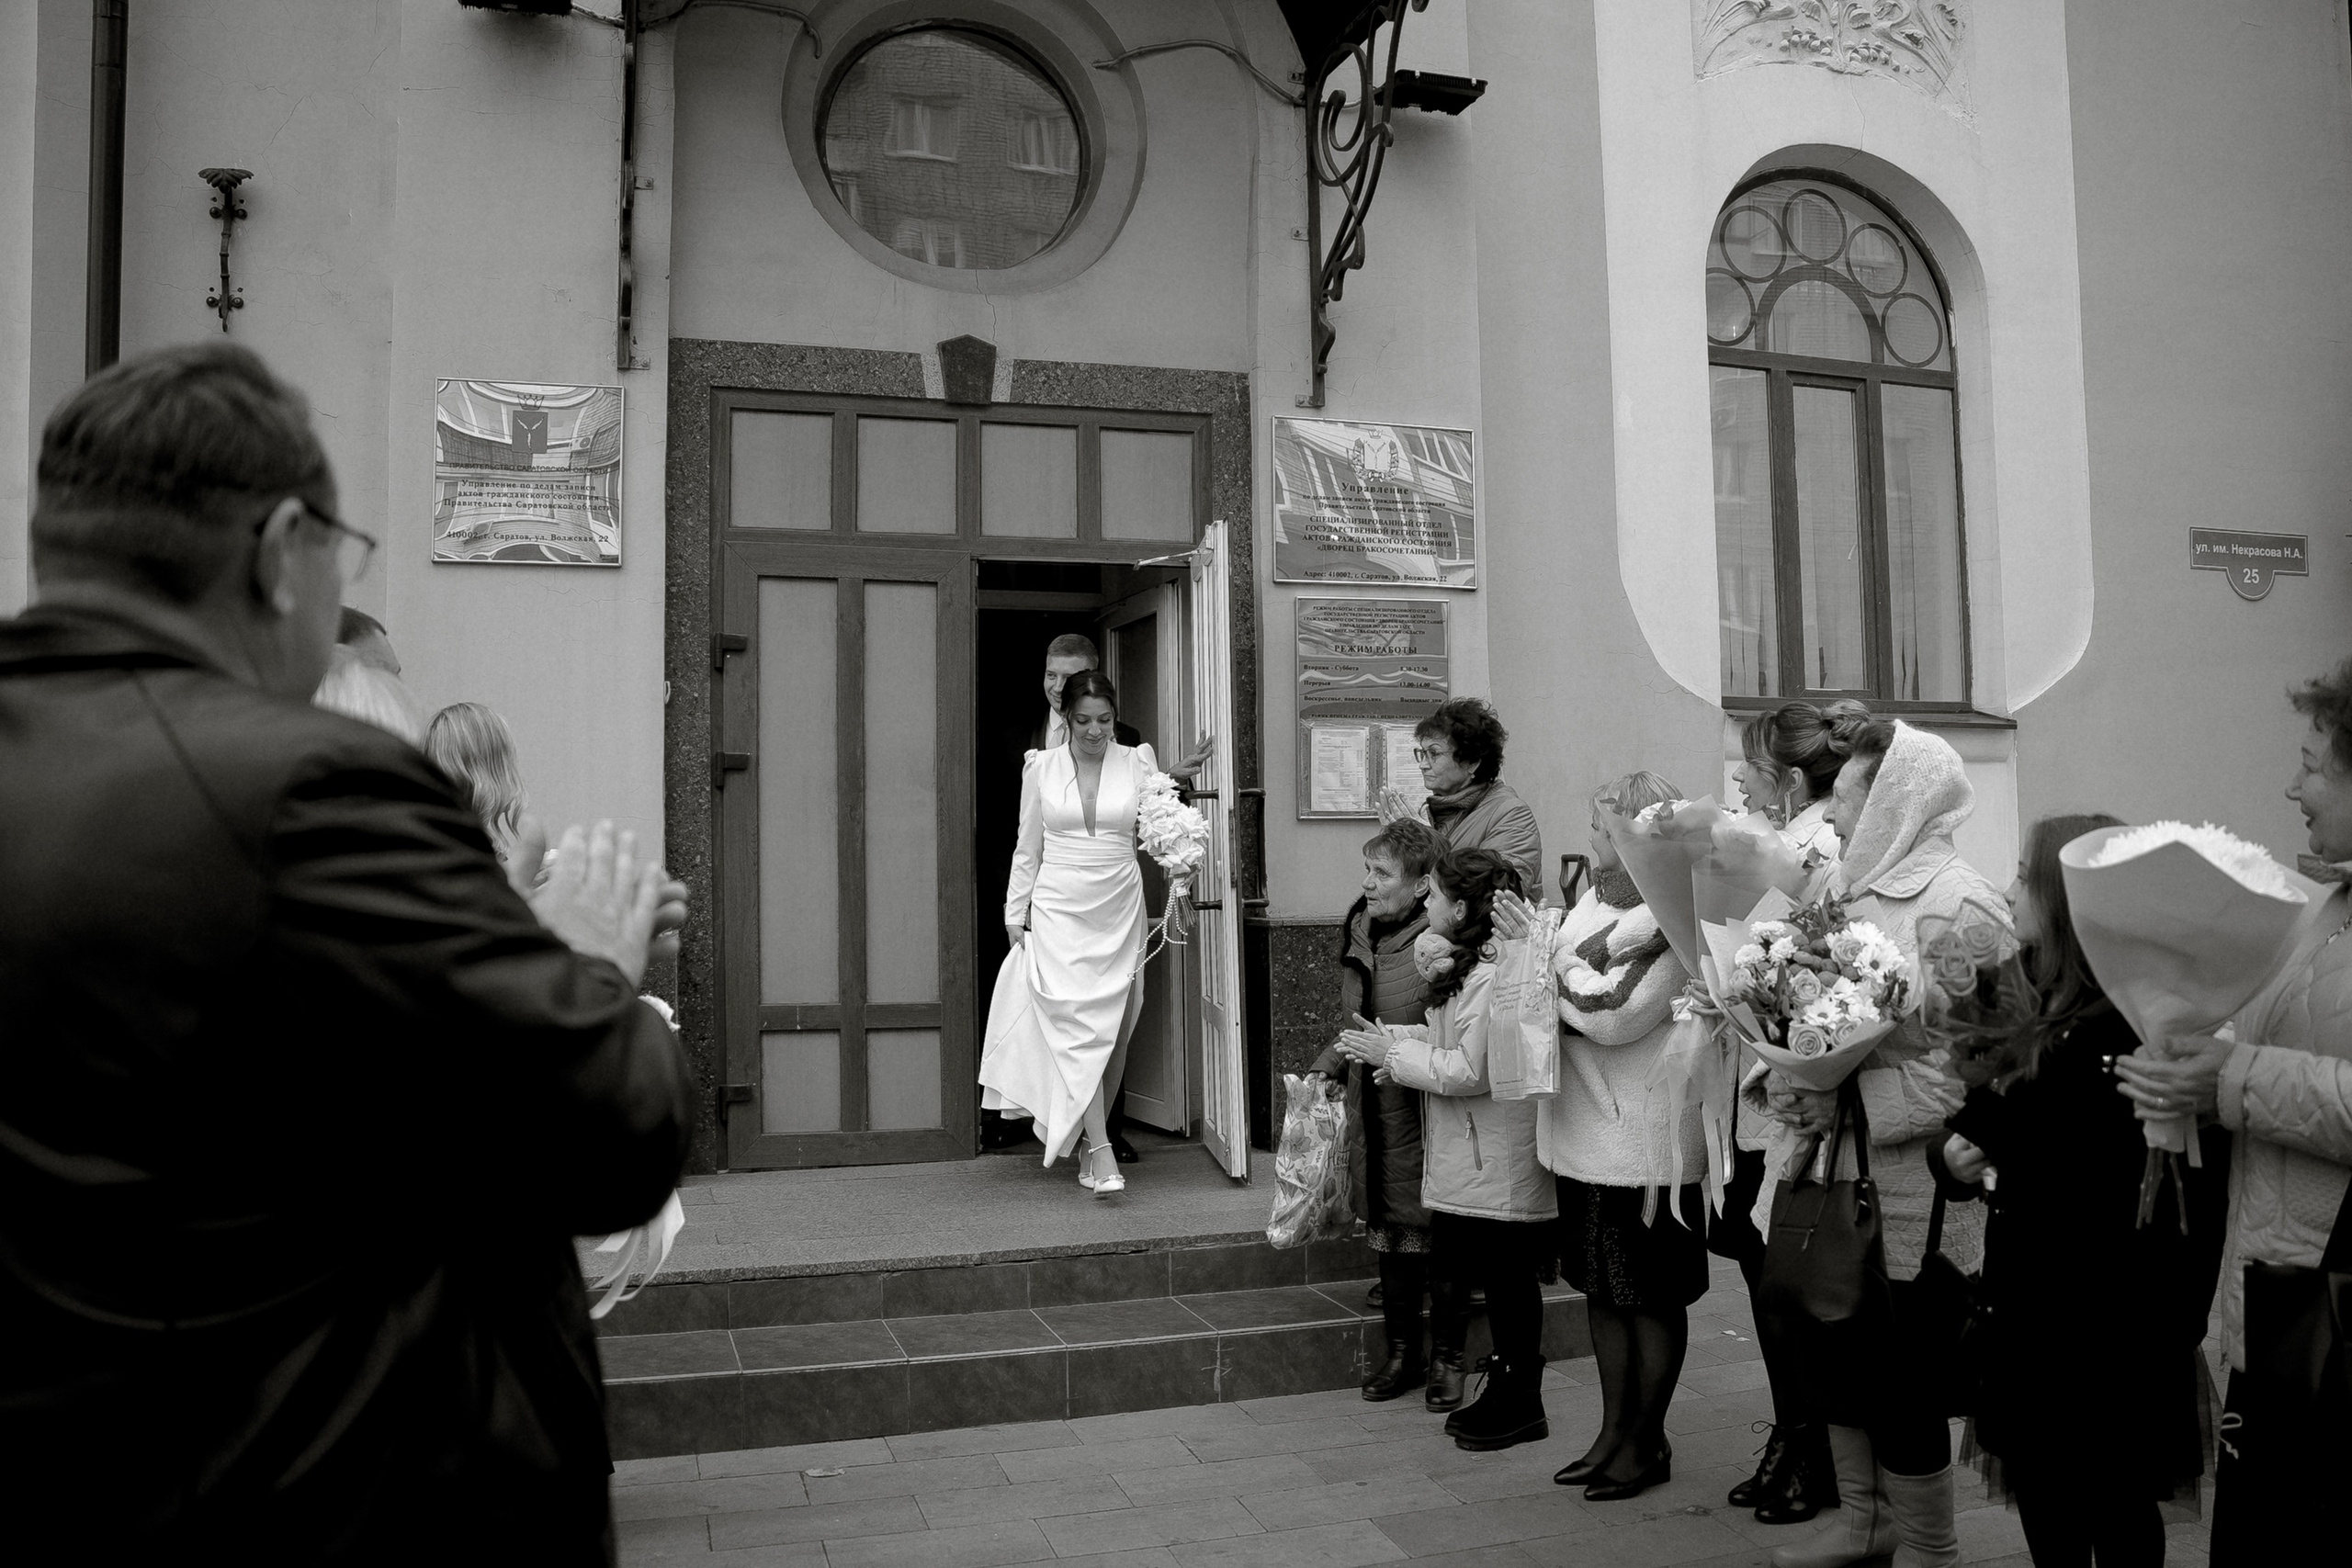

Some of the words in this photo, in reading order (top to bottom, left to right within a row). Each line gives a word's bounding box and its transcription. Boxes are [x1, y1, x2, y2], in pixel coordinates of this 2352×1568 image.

[449, 462, 514, 471] ПРАВИТЕЛЬСТВО
[461, 479, 516, 489] Управление
[1341, 482, 1409, 494] Управление
[553, 493, 599, 502] состояния
[444, 498, 513, 508] Правительства
[515, 501, 573, 510] Саратовской
[576, 502, 613, 512] области
[1309, 515, 1414, 527] СПЕЦИАЛИЗИРОВАННЫЙ
[1415, 521, 1442, 529] ОТДЕЛ
[1305, 525, 1389, 536] ГОСУДАРСТВЕННОЙ
[1391, 528, 1449, 538] РЕГИСТРАЦИИ
[493, 532, 532, 542] Саратов,
[535, 534, 548, 543] ул.
[551, 534, 595, 543] Волжская,
[598, 535, 609, 543] 22
[1302, 534, 1330, 542] АКТОВ
[1401, 538, 1452, 547] СОСТОЯНИЯ
[1317, 544, 1354, 553] «ДВОРЕЦ
[2195, 543, 2211, 554] ул.
[2212, 545, 2229, 554] им.
[2231, 543, 2282, 558] Некрасова
[2284, 547, 2303, 558] Н.А.
[1303, 570, 1327, 579] Адрес:
[1329, 571, 1353, 580] 410002,
[1361, 572, 1390, 581] Саратов,
[2243, 568, 2260, 583] 25
[1334, 645, 1373, 653] РЕЖИМ
[1376, 646, 1418, 655] РАБОТЫ
[1334, 664, 1359, 672] Суббота
